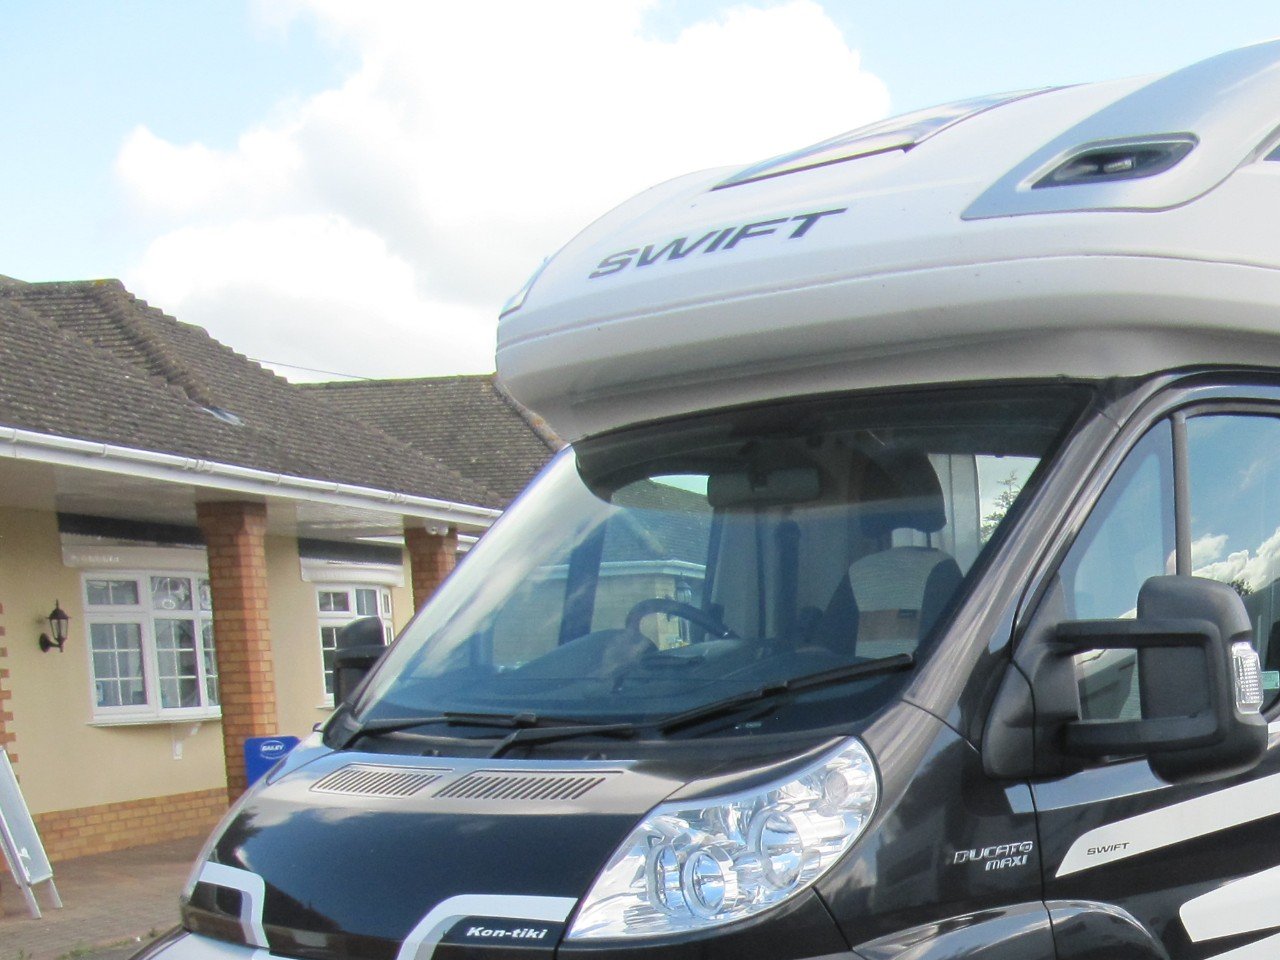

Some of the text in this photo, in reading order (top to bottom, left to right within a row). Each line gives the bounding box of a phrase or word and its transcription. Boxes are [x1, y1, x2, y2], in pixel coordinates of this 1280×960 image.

[588, 207, 848, 279] SWIFT
[953, 841, 1034, 864] DUCATO
[1086, 842, 1130, 856] SWIFT
[985, 855, 1028, 871] MAXI
[466, 926, 548, 939] Kon-tiki
